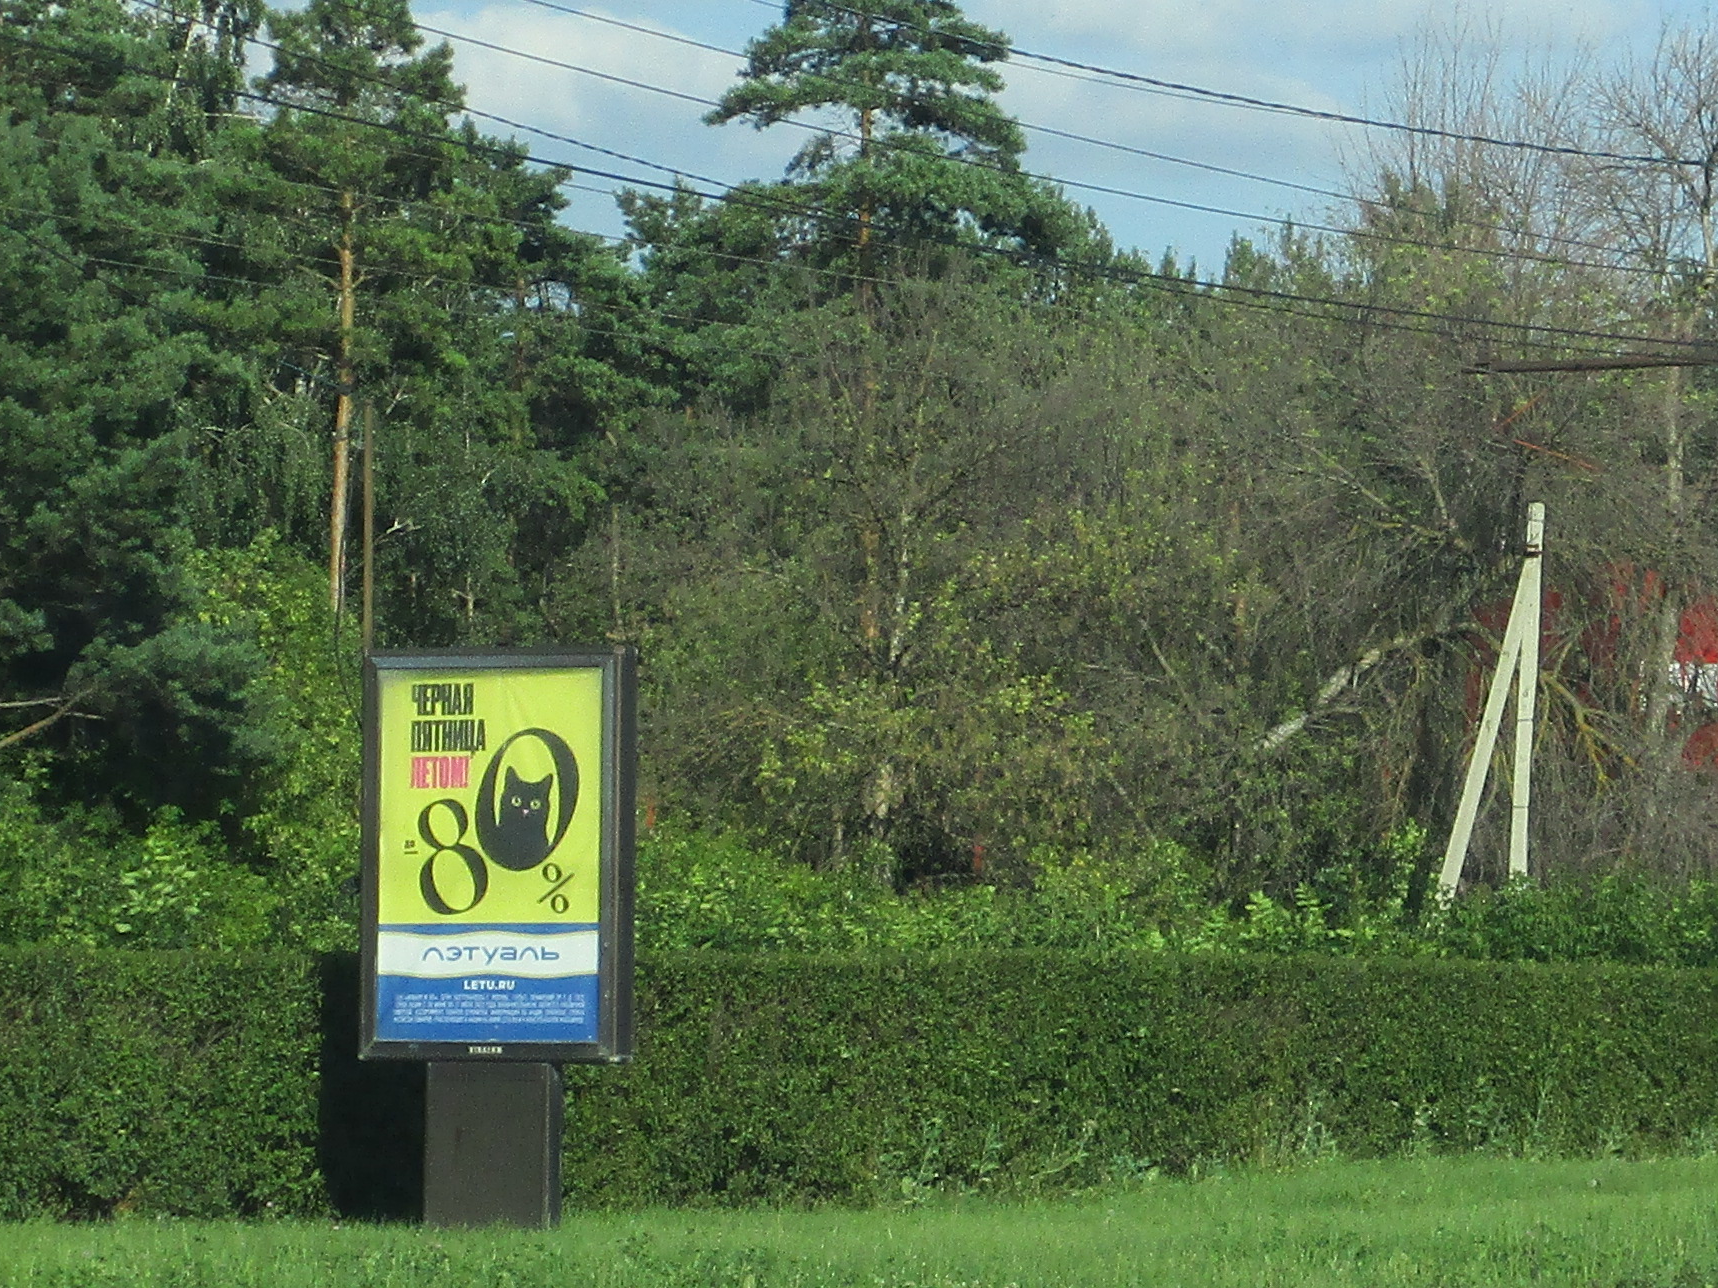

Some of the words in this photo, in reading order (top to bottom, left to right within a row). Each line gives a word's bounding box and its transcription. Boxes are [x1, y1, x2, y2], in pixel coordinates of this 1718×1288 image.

[411, 682, 474, 716] ЧЕРНАЯ
[410, 719, 486, 758] ПЯТНИЦА
[410, 756, 470, 789] ЛЕТОМ!
[463, 980, 516, 991] LETU.RU
